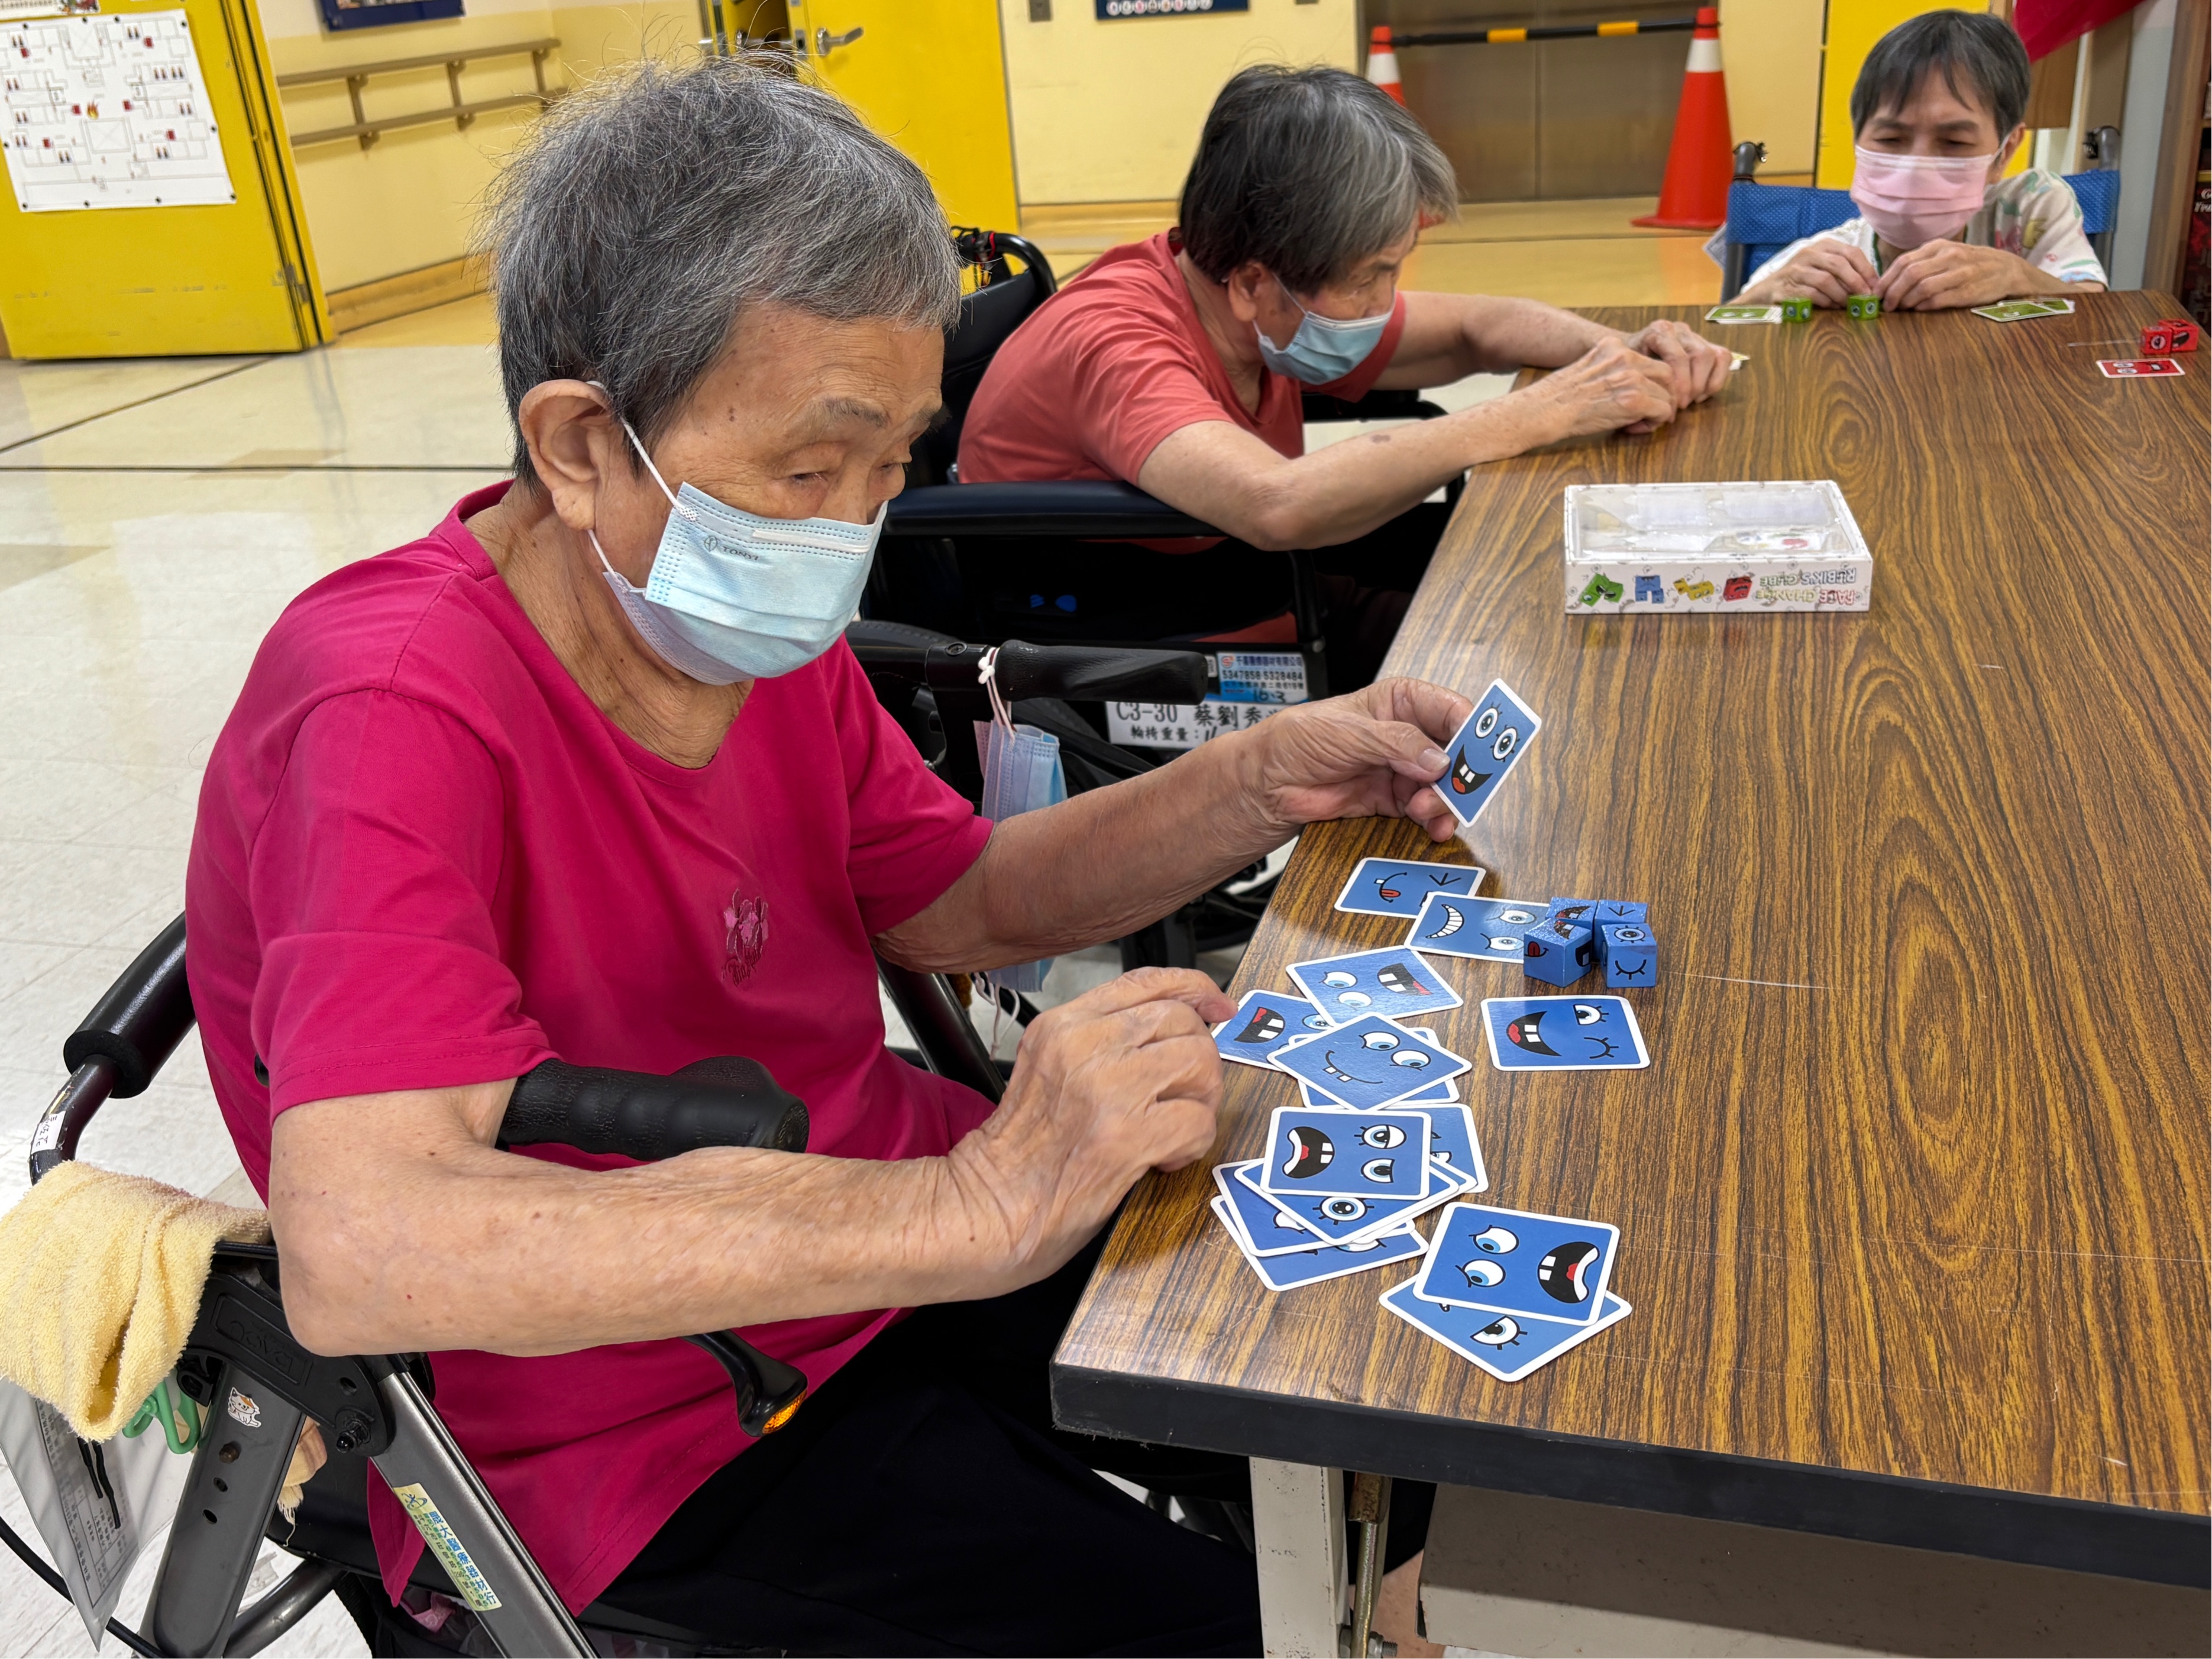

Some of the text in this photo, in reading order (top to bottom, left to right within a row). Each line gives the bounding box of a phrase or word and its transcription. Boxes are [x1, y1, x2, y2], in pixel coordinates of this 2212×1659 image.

[723, 546, 759, 561] TONYI
[1760, 568, 1857, 587] RUBIK'S CUBE
[1756, 589, 1856, 605] FACE CHANGE
[1116, 702, 1178, 723] C3-30
